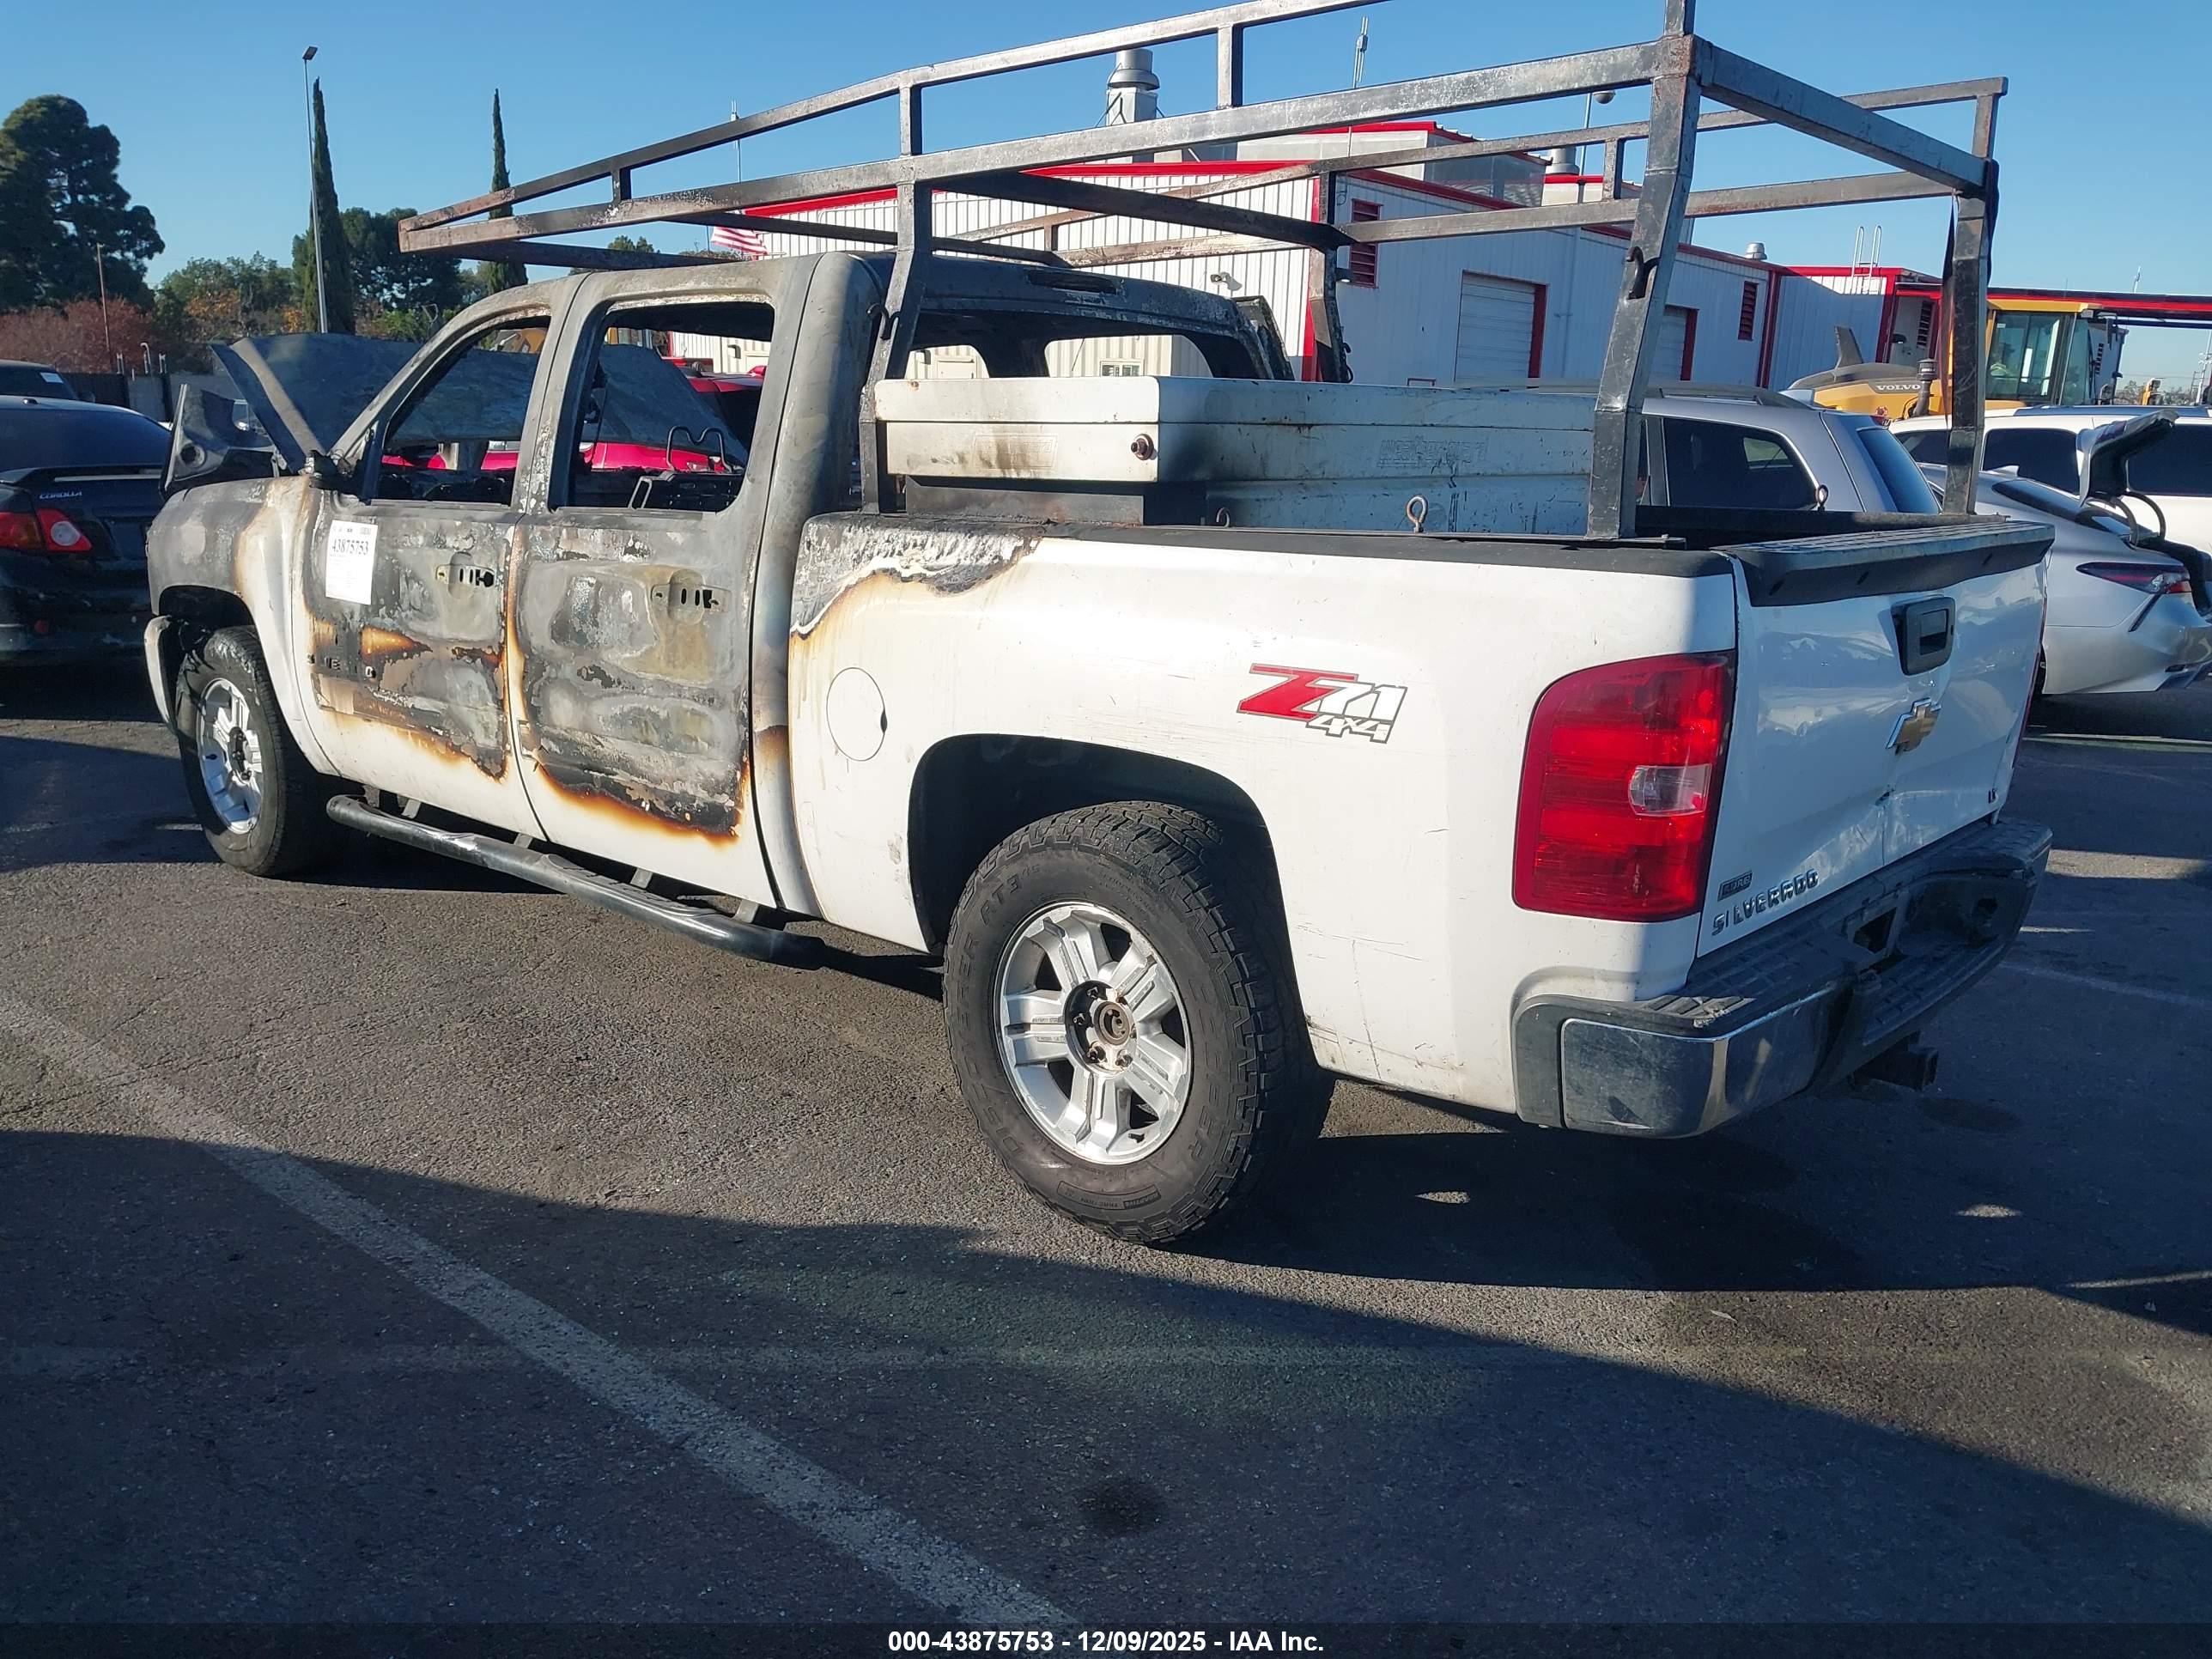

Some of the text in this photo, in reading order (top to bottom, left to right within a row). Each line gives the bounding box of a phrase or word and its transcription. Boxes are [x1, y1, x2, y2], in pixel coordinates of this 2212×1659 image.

[331, 538, 368, 556] 43875753
[1237, 663, 1408, 726] Z71
[1711, 868, 1819, 936] SILVERADO
